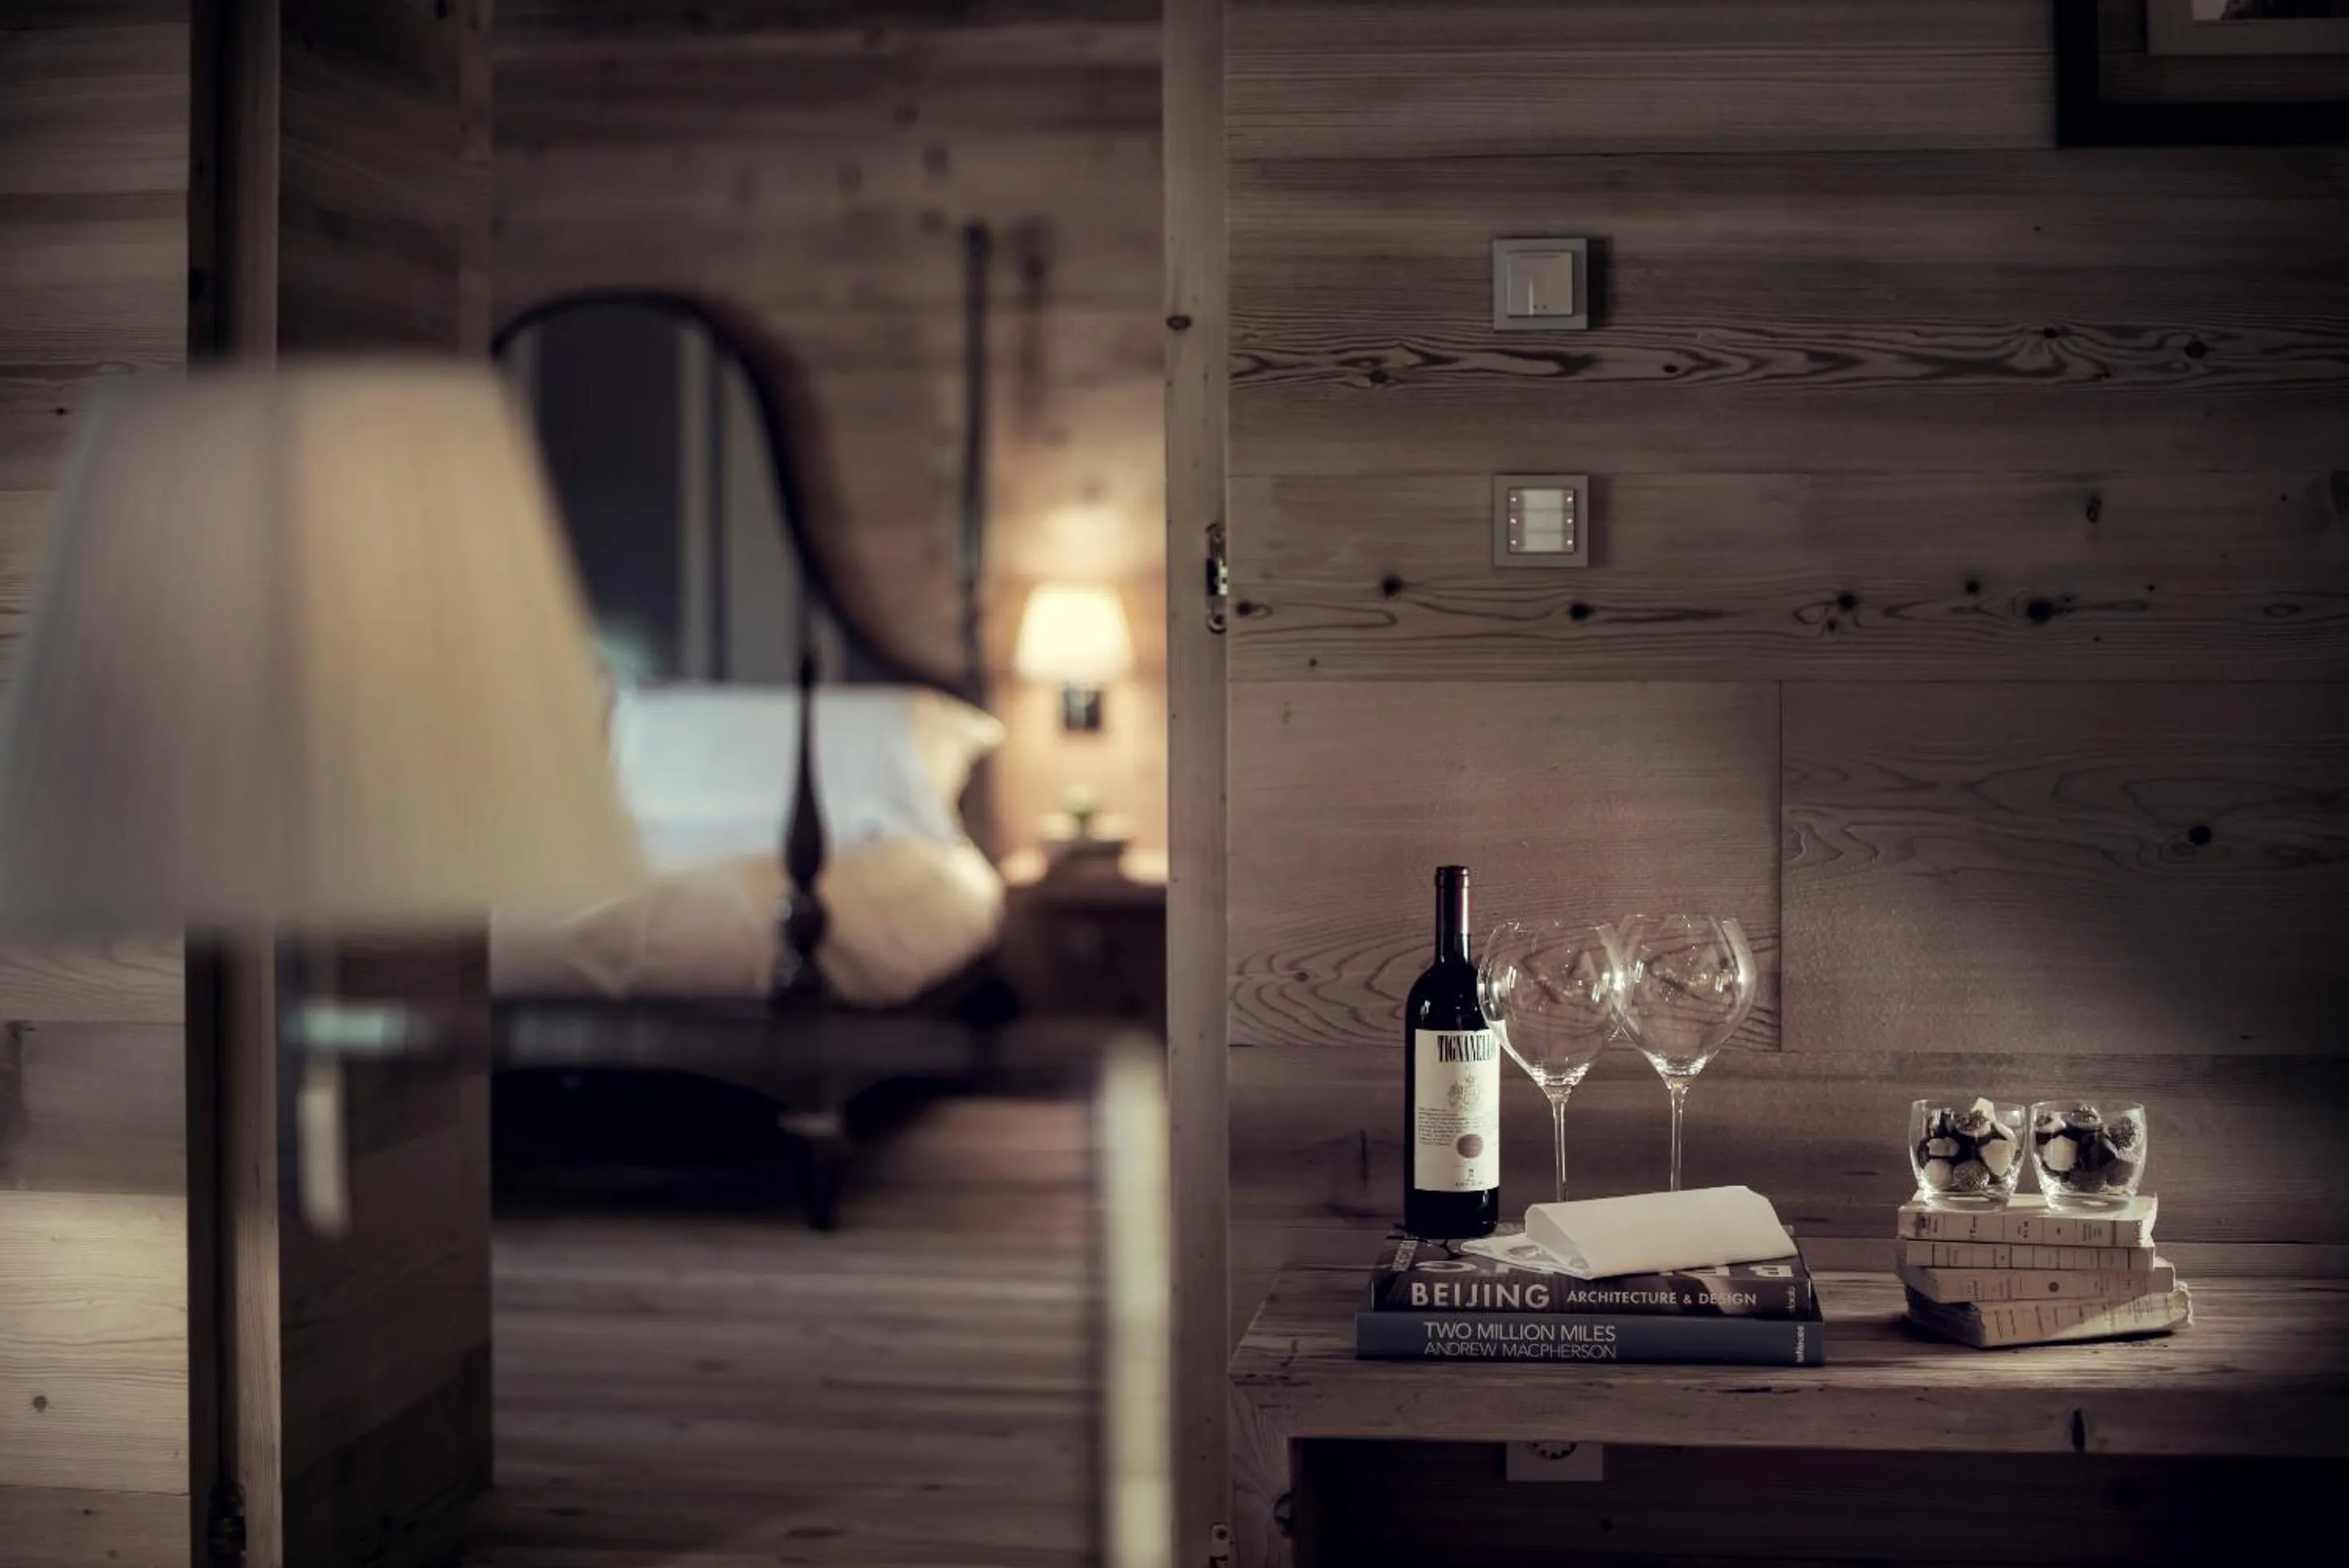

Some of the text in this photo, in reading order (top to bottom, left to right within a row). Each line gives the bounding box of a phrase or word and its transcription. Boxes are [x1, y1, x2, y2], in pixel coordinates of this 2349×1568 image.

[1411, 1282, 1550, 1309] BEIJING
[1566, 1290, 1757, 1306] ARCHITECTURE & DESIGN
[1424, 1321, 1617, 1342] TWO MILLION MILES
[1423, 1341, 1617, 1359] ANDREW MACPHERSON
